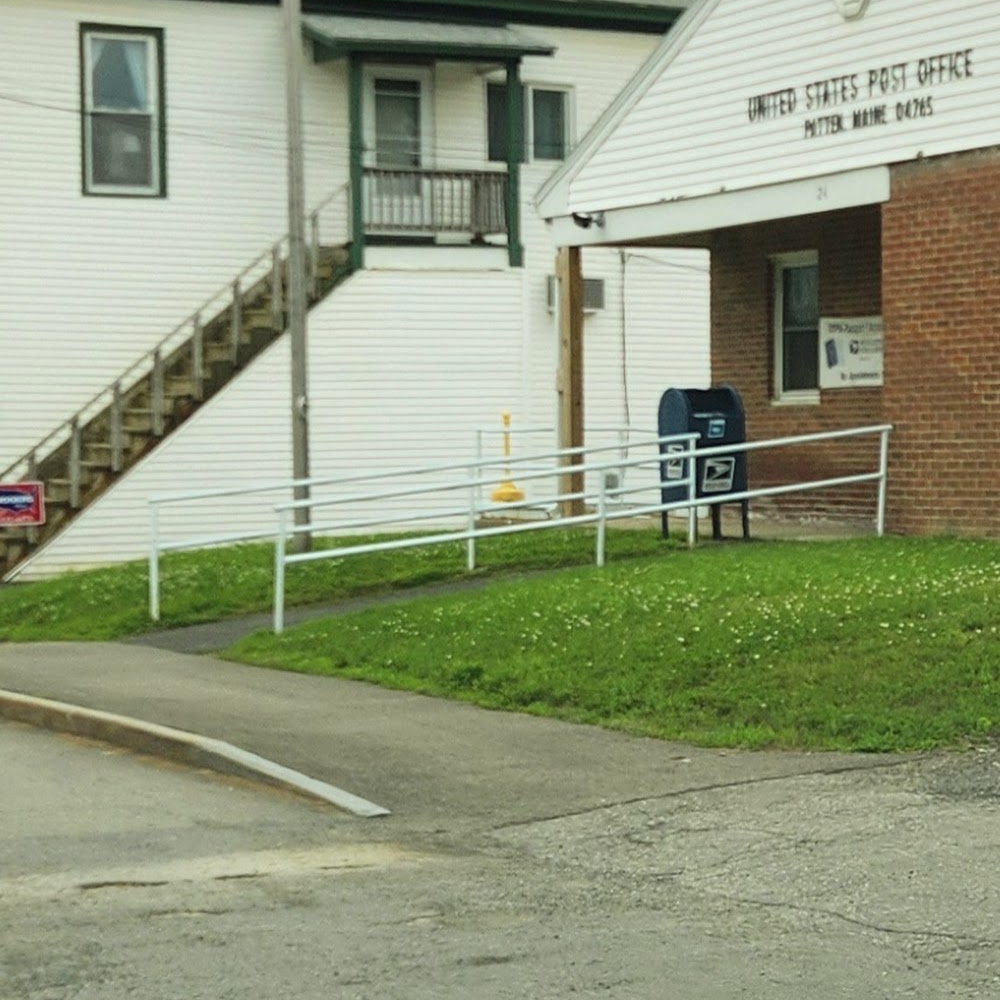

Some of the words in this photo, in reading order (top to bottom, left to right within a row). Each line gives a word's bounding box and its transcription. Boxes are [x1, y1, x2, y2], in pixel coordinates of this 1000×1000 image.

[748, 88, 797, 122] UNITED
[806, 74, 858, 110] STATES
[868, 63, 909, 98] POST
[917, 48, 974, 86] OFFICE
[853, 104, 887, 129] MAINE
